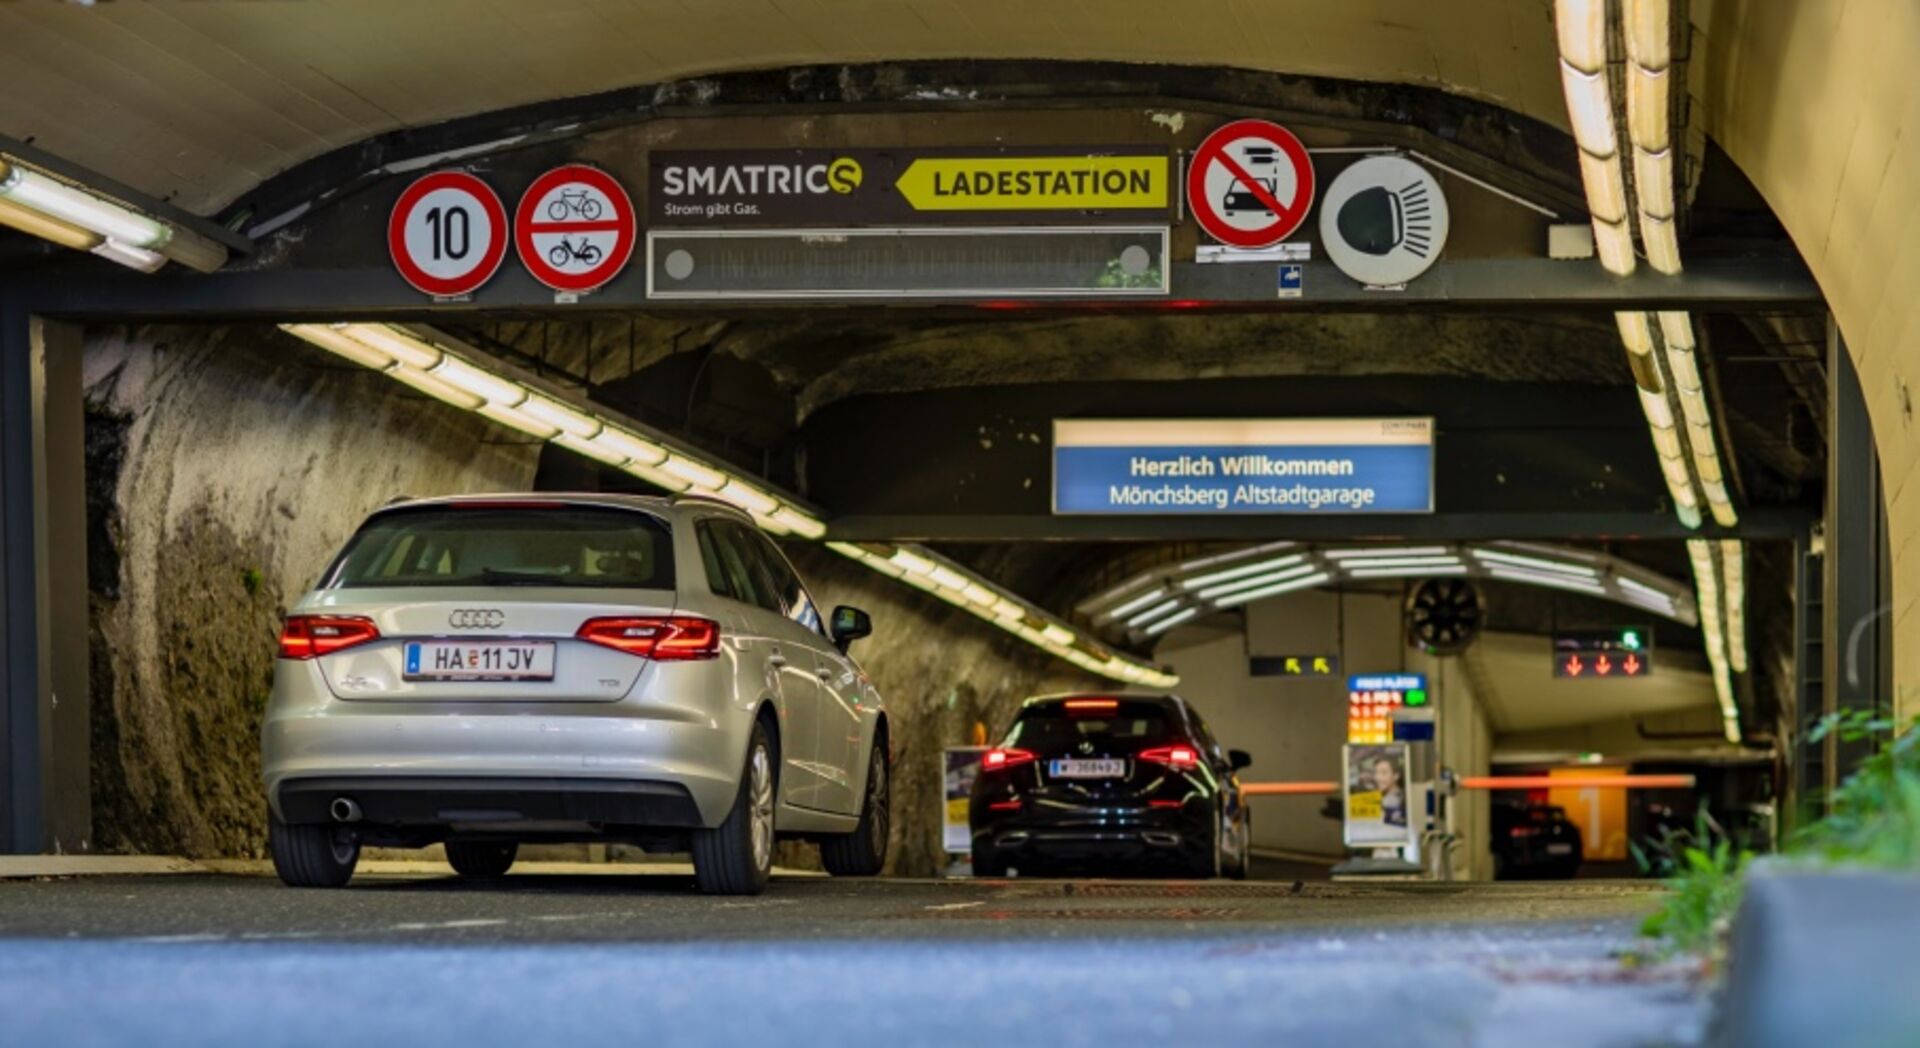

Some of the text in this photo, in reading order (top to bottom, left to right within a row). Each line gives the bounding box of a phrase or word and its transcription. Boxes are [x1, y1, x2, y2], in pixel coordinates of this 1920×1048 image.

[934, 169, 1150, 196] LADESTATION
[664, 202, 761, 219] Strom gibt Gas.
[426, 206, 470, 260] 10
[1130, 456, 1354, 476] Herzlich Willkommen
[1110, 484, 1376, 508] Mönchsberg Altstadtgarage
[435, 648, 464, 669] HA
